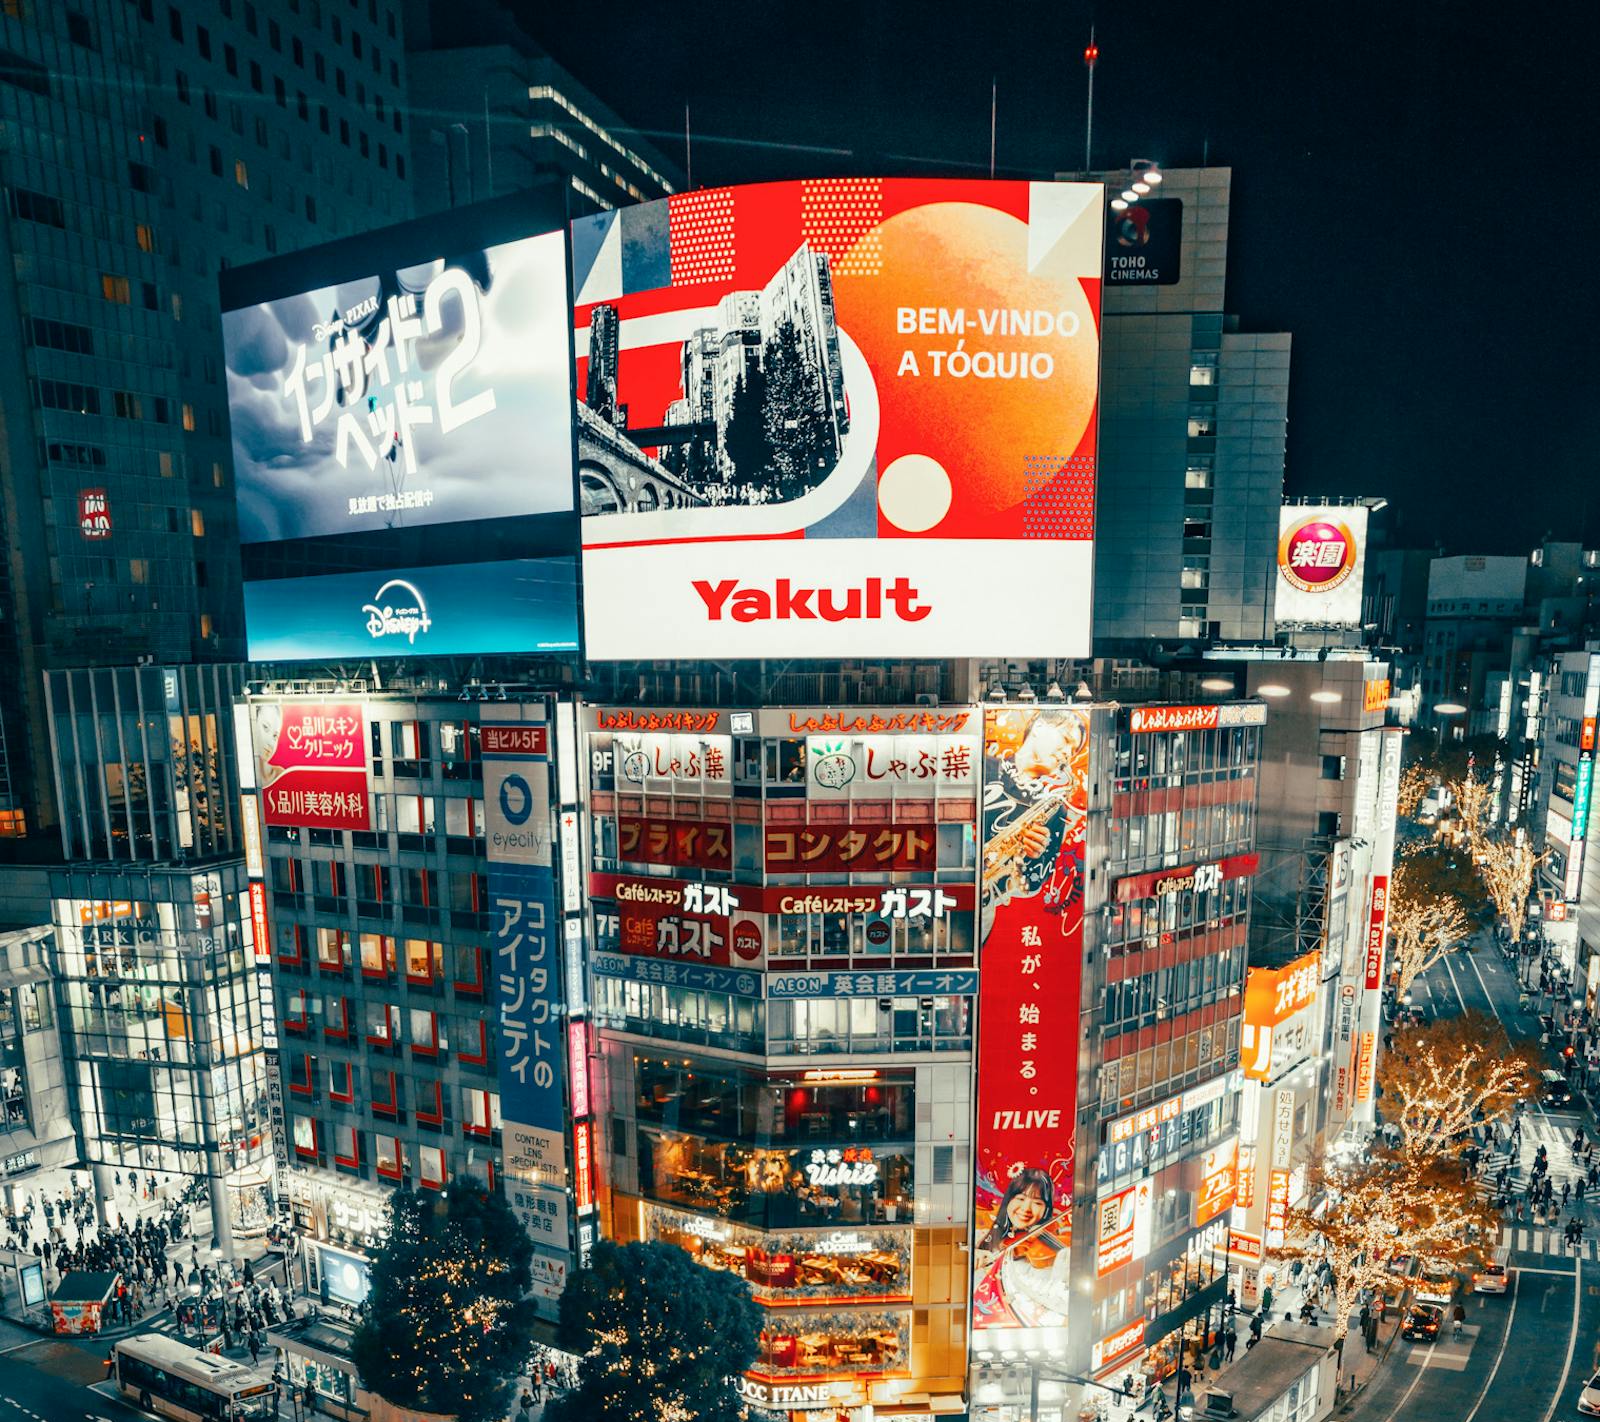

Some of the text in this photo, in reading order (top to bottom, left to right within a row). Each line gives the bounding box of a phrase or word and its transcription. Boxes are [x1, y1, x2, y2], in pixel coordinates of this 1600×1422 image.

[1111, 269, 1159, 280] CINEMAS
[1112, 256, 1146, 269] TOHO
[345, 296, 379, 324] PIXAR
[897, 308, 1079, 337] BEM-VINDO
[285, 267, 497, 443] インサイド 2
[897, 340, 1054, 380] A TÓQUIO
[336, 384, 433, 474] ヘッド
[1291, 540, 1345, 567] 楽園
[691, 577, 933, 622] Yakult
[303, 715, 359, 738] 品川スキン
[598, 711, 719, 732] しゃぶしゃぶバイキング
[790, 712, 970, 733] しゃぶしゃぶバイキング
[303, 738, 354, 759] クリニック
[487, 729, 541, 750] 当ビル5F
[592, 751, 612, 771] 9F
[655, 747, 724, 780] しゃぶ葉
[867, 745, 971, 780] しゃぶ葉
[277, 790, 363, 818] 品川美容外科
[492, 830, 542, 855] eyecity
[619, 823, 728, 858] プライス
[767, 829, 929, 862] コンタクト
[1193, 864, 1223, 893] ガスト
[683, 883, 739, 916] ガスト
[880, 888, 957, 919] ガスト
[597, 915, 619, 937] 7F
[657, 917, 724, 957] ガスト
[736, 937, 759, 950] ガスト
[1367, 921, 1384, 978] TaxFree
[596, 957, 625, 972] AEON
[635, 961, 731, 986] 英会話イーオン
[775, 975, 974, 996] AEON 英会話イーオン
[497, 899, 530, 1084] アイシティ
[527, 902, 553, 1089] コンタクトの
[1019, 925, 1043, 1096] 私が、始まる。
[267, 1057, 278, 1066] 3F
[270, 1083, 281, 1102] 内科
[515, 1132, 550, 1149] CONTACT
[523, 1147, 543, 1160] LENS
[510, 1157, 558, 1175] SPECIALISTS
[1098, 1135, 1143, 1179] AGA
[1188, 1220, 1225, 1258] LUSH
